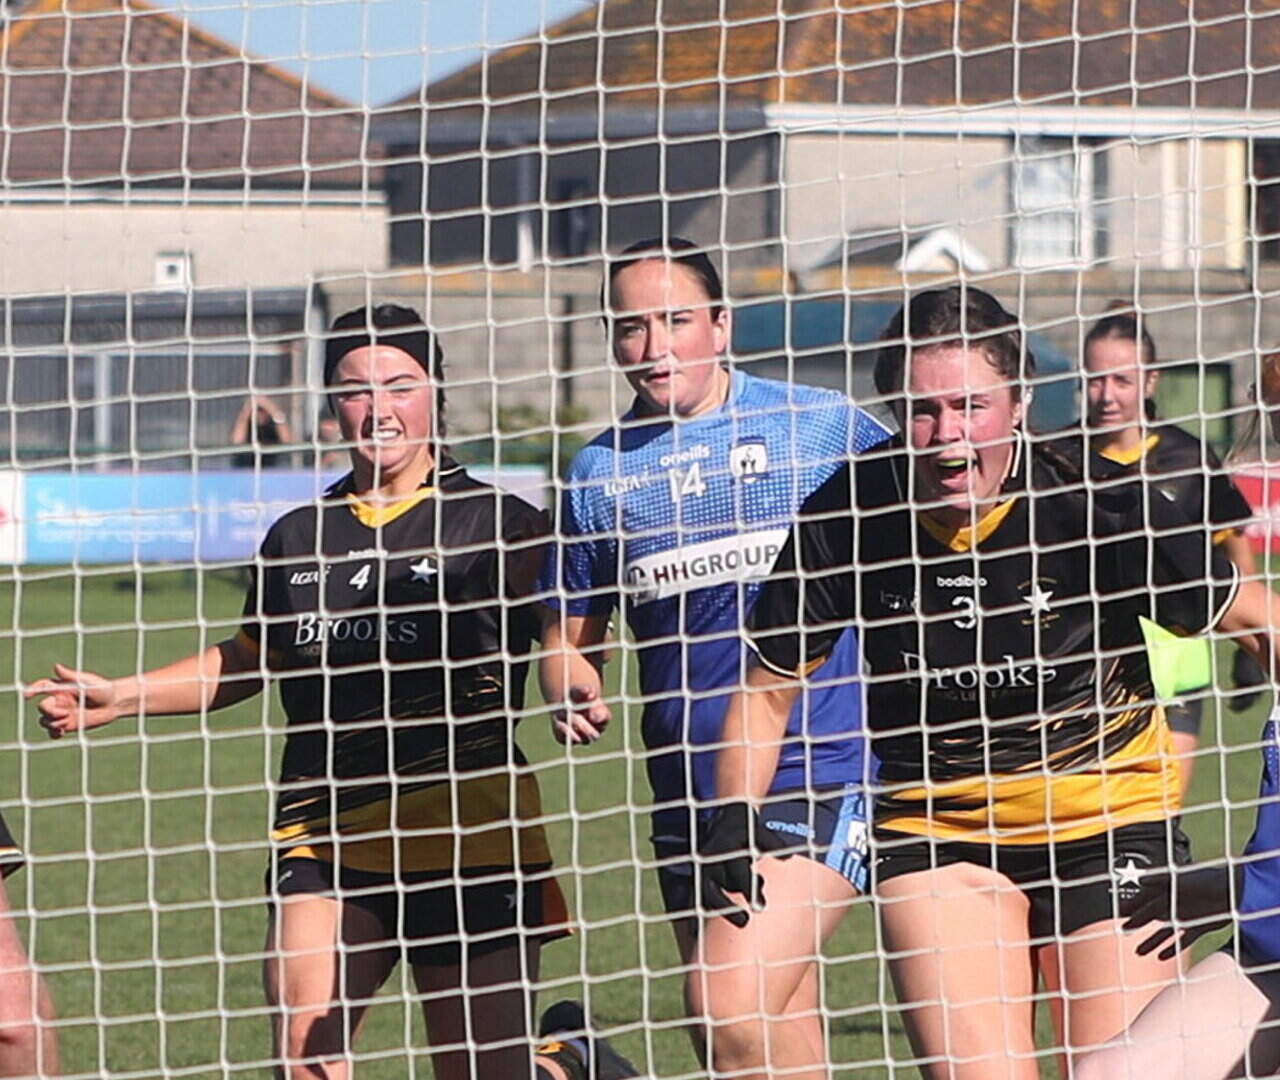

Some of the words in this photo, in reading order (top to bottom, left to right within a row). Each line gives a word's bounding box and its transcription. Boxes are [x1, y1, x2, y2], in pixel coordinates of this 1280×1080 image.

[669, 461, 705, 503] 14
[349, 564, 371, 590] 4
[653, 545, 779, 585] HHGROUP
[295, 612, 418, 645] Brooks
[952, 595, 976, 629] 3
